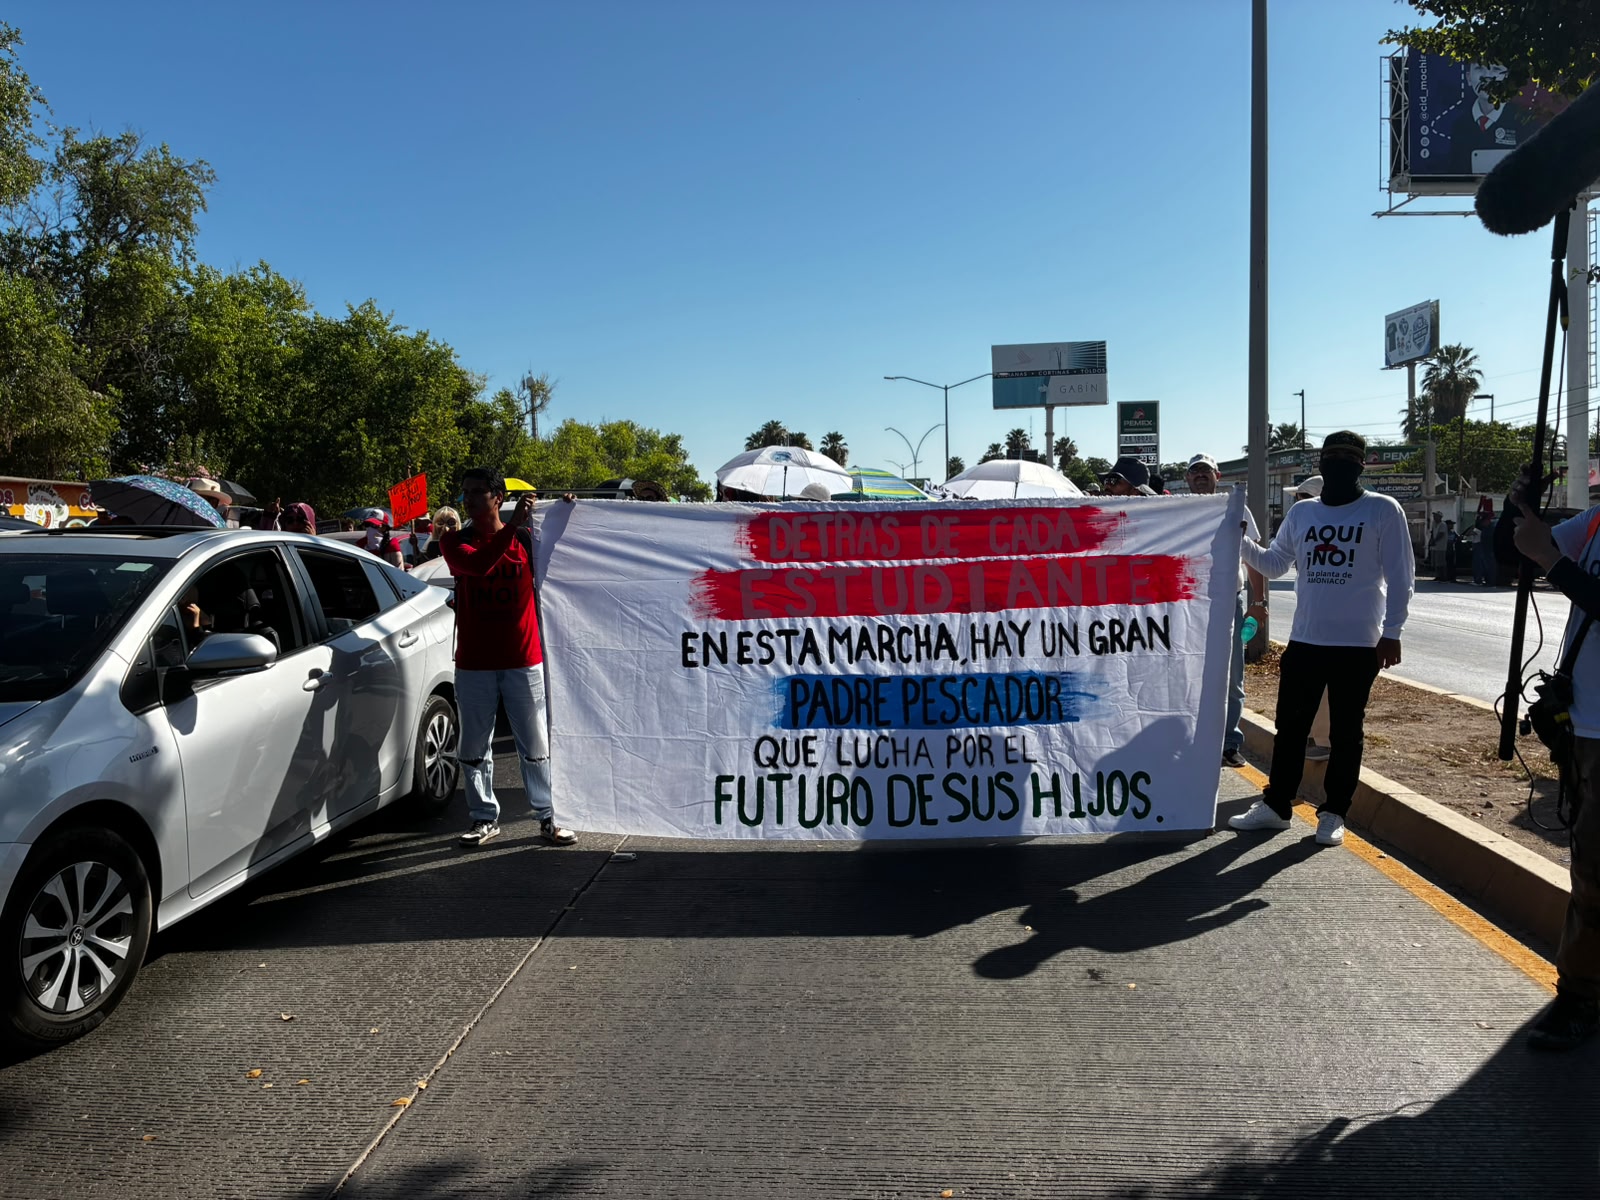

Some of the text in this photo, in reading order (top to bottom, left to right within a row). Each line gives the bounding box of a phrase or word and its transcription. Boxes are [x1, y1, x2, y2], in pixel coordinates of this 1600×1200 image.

[920, 515, 961, 556] DE
[989, 511, 1079, 554] CADA
[1304, 522, 1365, 546] AQUÍ
[740, 558, 1153, 618] ESTUDIANTE
[682, 632, 728, 667] EN
[737, 628, 822, 666] ESTA
[970, 620, 1031, 660] HAY
[1041, 620, 1080, 657] UN
[1089, 615, 1171, 656] GRAN
[790, 676, 1064, 727] PADRE PESCADOR
[754, 735, 1037, 769] QUE LUCHA POR EL
[715, 773, 873, 828] FUTURO
[887, 773, 938, 827] DE
[942, 771, 1019, 822] SUS
